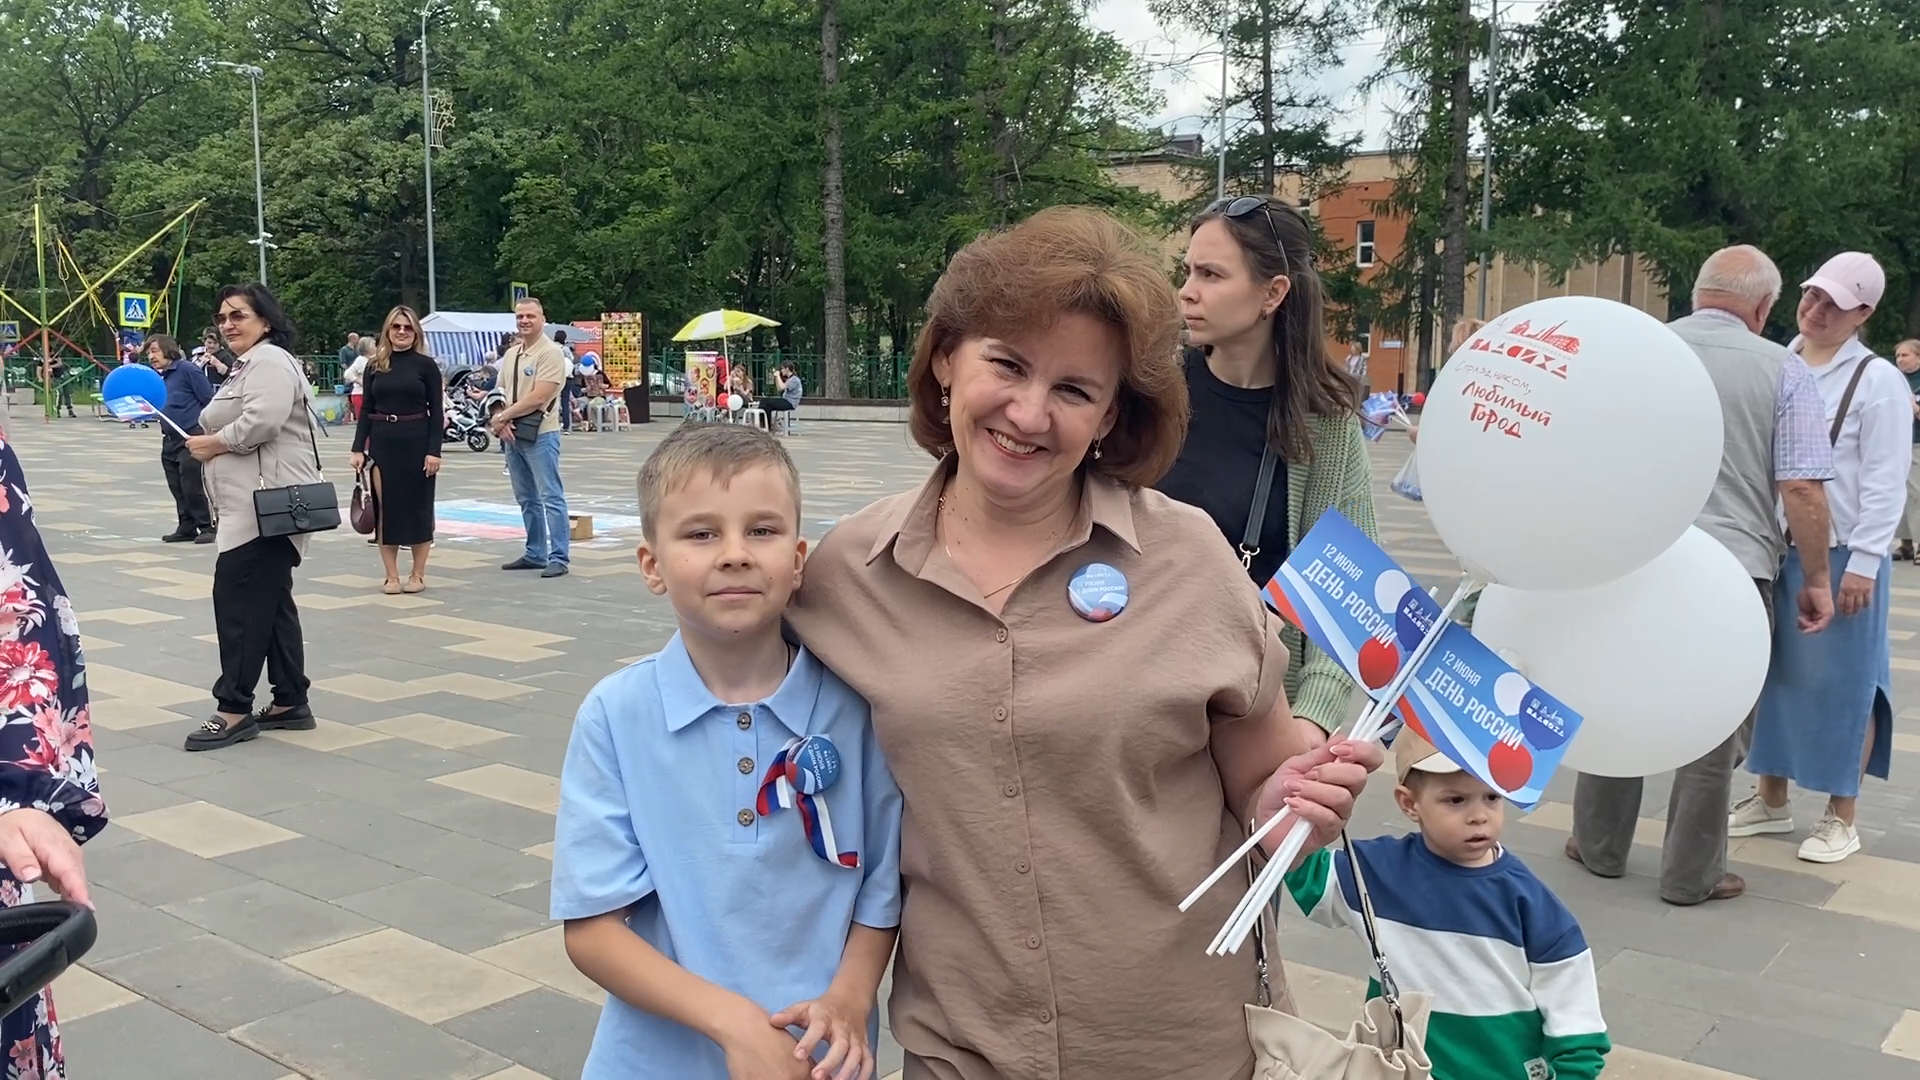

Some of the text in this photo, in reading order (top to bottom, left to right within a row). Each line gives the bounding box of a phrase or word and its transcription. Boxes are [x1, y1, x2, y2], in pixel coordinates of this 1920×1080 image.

[1321, 543, 1364, 582] 12 ИЮНЯ
[1301, 558, 1398, 649] ДЕНЬ РОССИИ
[1441, 650, 1482, 687] 12 ИЮНЯ
[1424, 666, 1525, 751] ДЕНЬ РОССИИ
